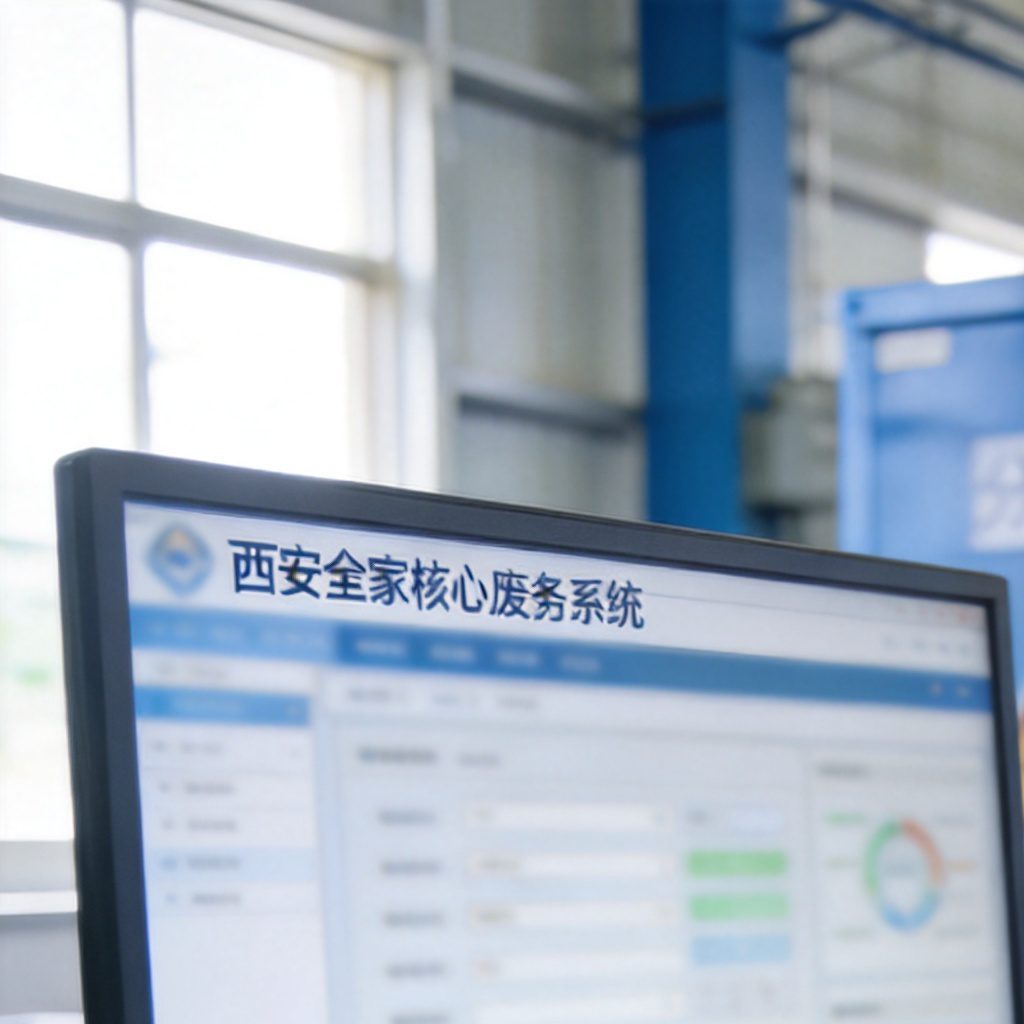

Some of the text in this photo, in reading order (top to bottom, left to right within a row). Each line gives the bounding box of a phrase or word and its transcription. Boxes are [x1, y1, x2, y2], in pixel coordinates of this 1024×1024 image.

[228, 538, 645, 630] 西安全家核心废务系统
